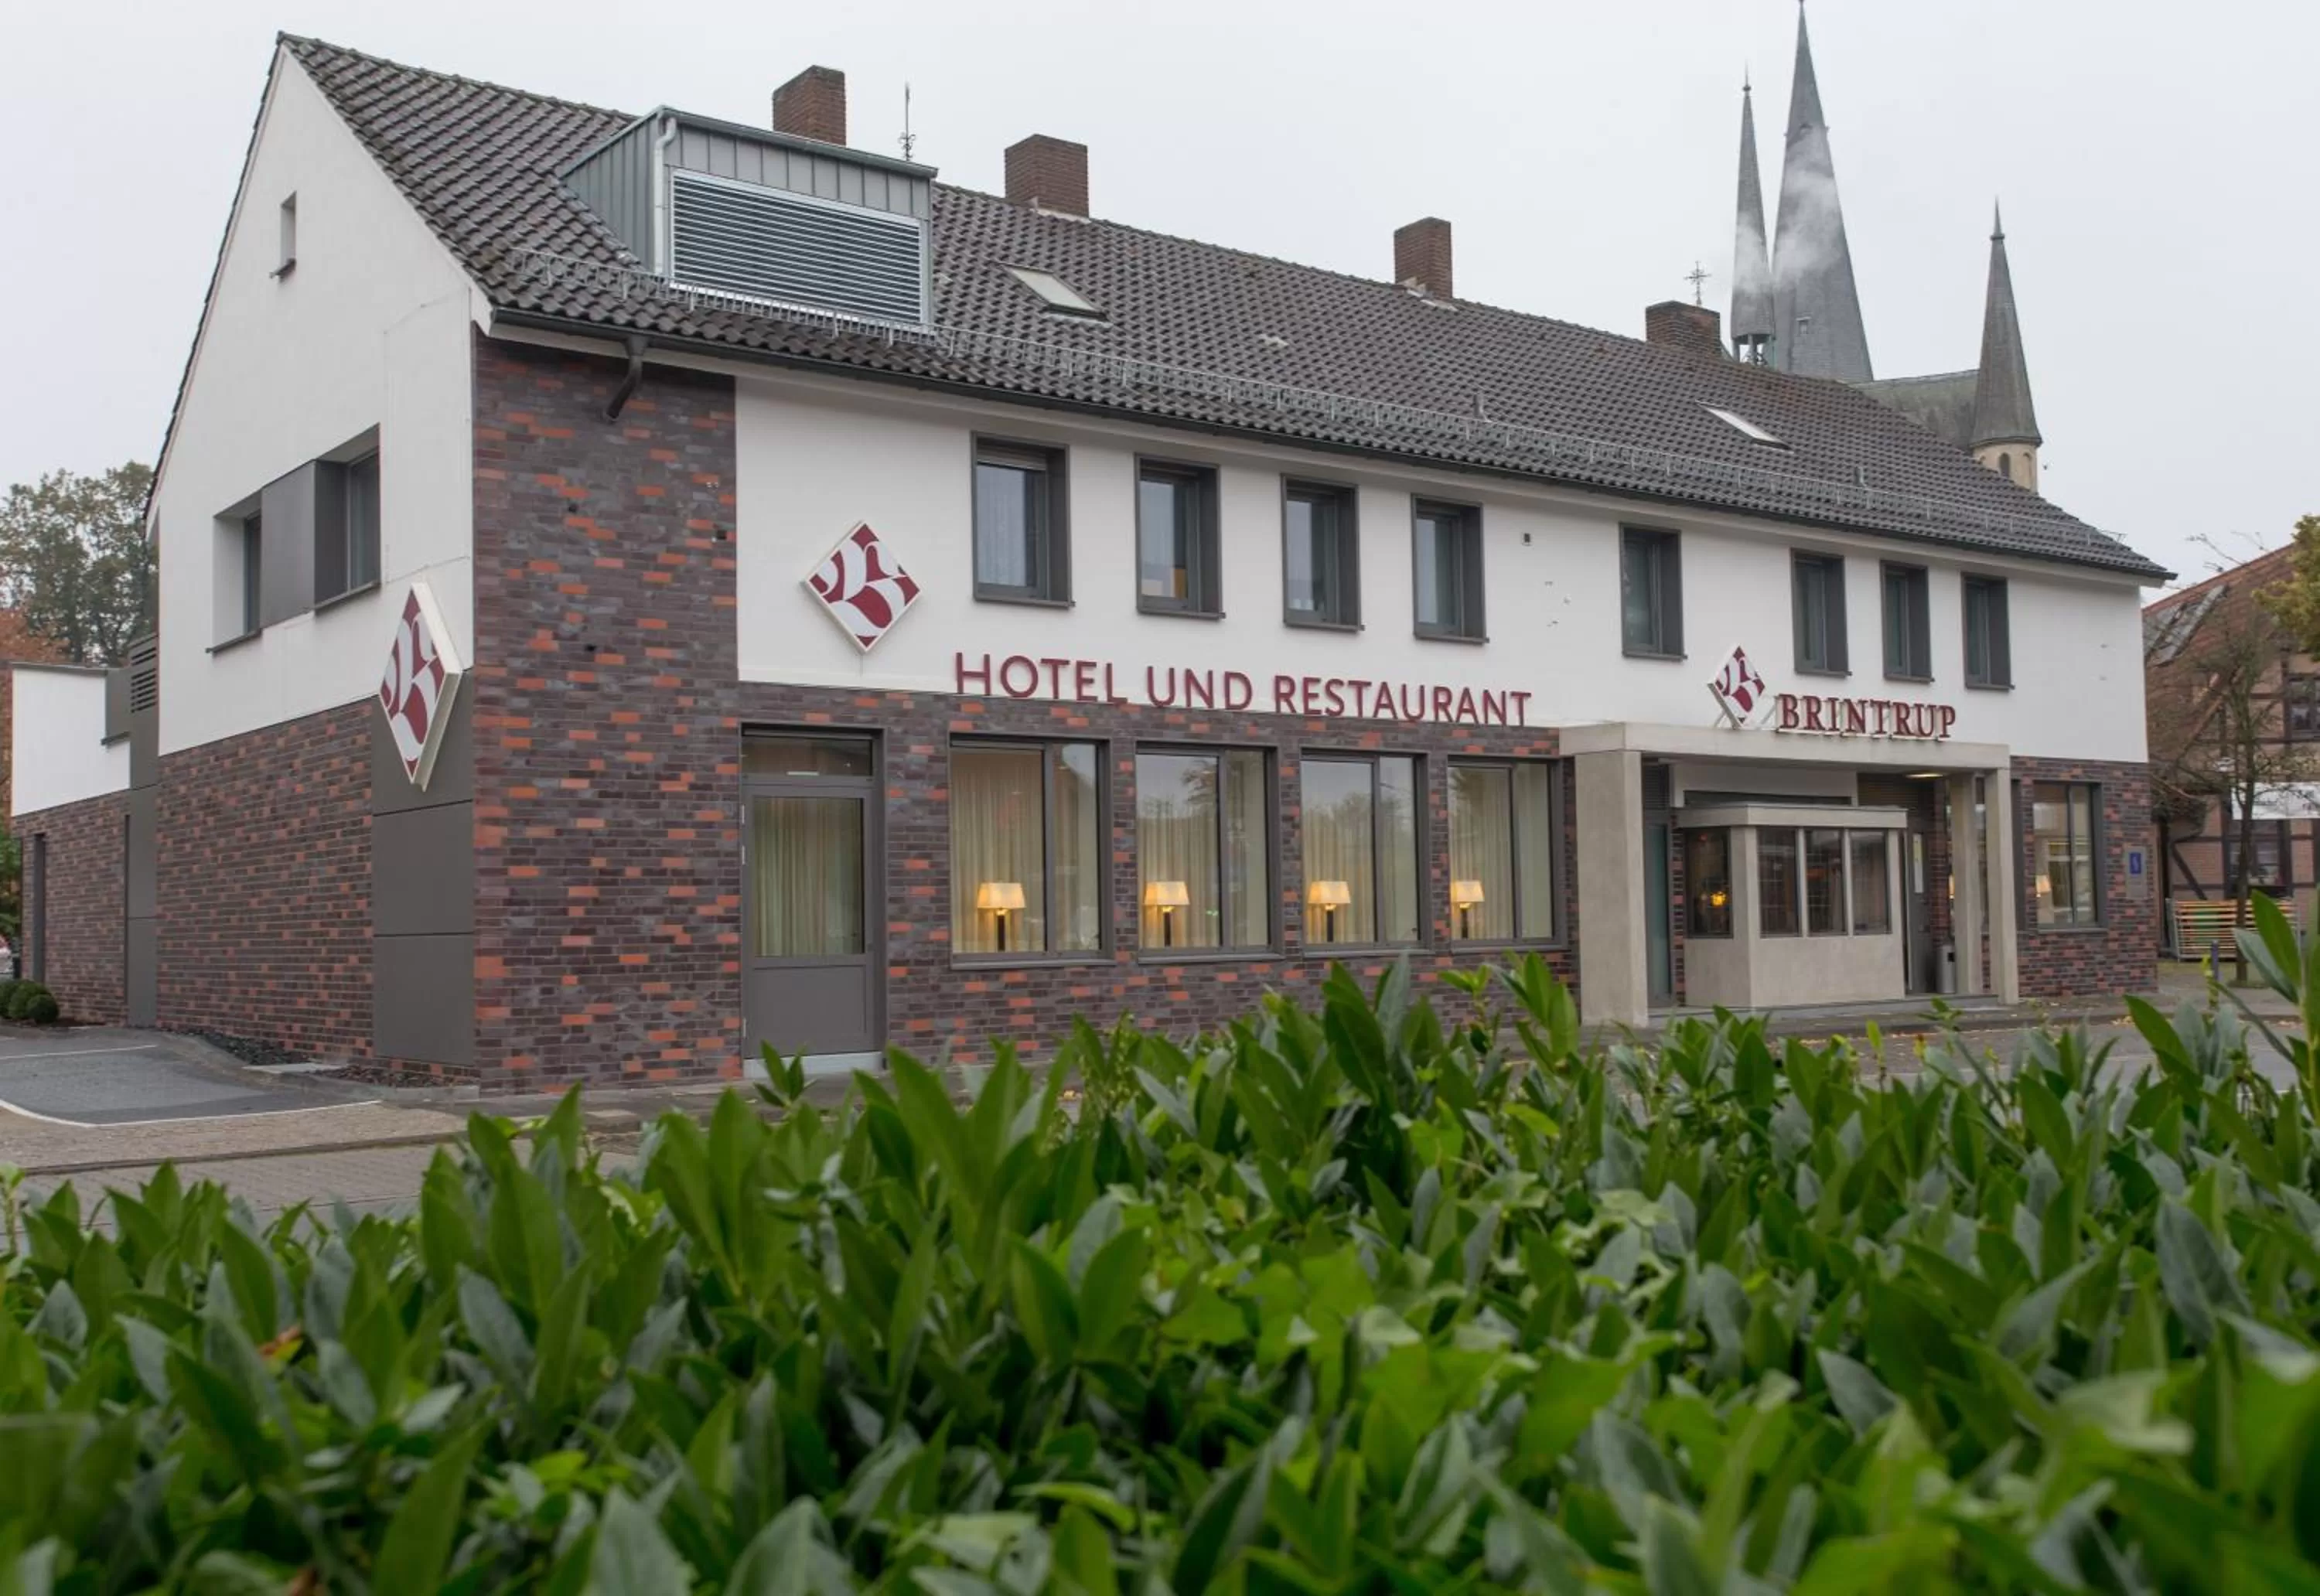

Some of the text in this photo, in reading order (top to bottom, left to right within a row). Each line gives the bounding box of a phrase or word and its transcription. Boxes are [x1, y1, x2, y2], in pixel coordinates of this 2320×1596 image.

[955, 652, 1532, 726] HOTEL UND RESTAURANT
[1778, 694, 1957, 738] BRINTRUP
